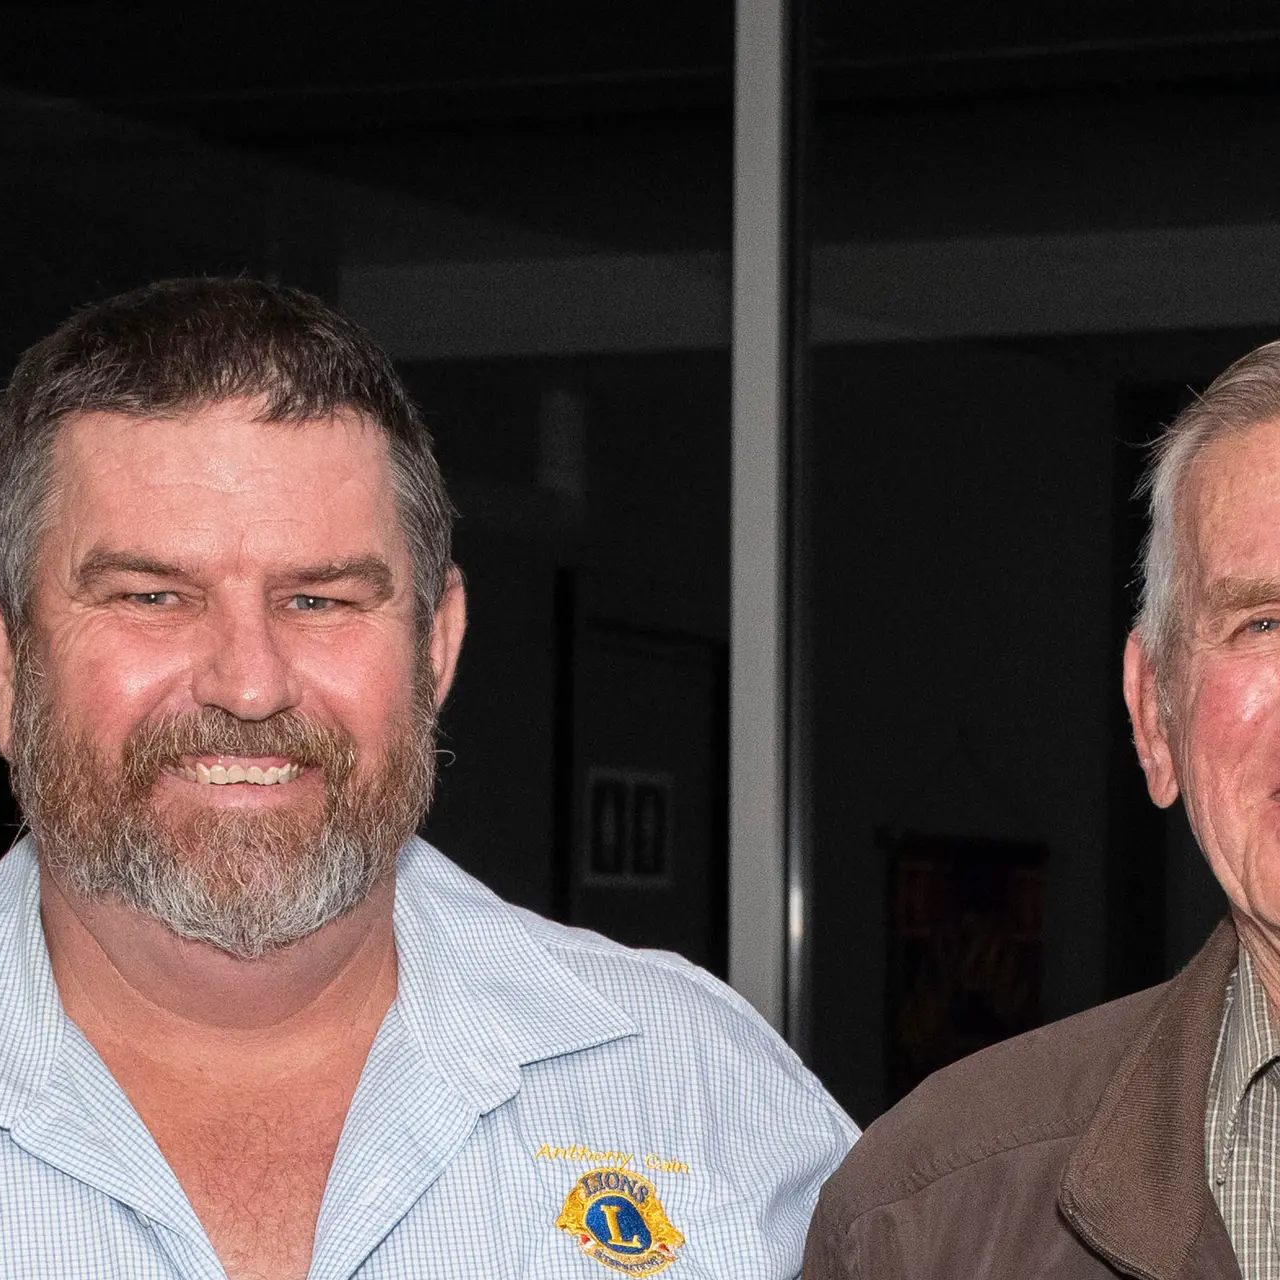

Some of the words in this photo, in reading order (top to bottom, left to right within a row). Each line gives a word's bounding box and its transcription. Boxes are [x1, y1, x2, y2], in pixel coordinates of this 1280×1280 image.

[536, 1144, 634, 1170] Anthony
[646, 1154, 690, 1175] Cain
[582, 1172, 649, 1203] LIONS
[601, 1205, 643, 1248] L
